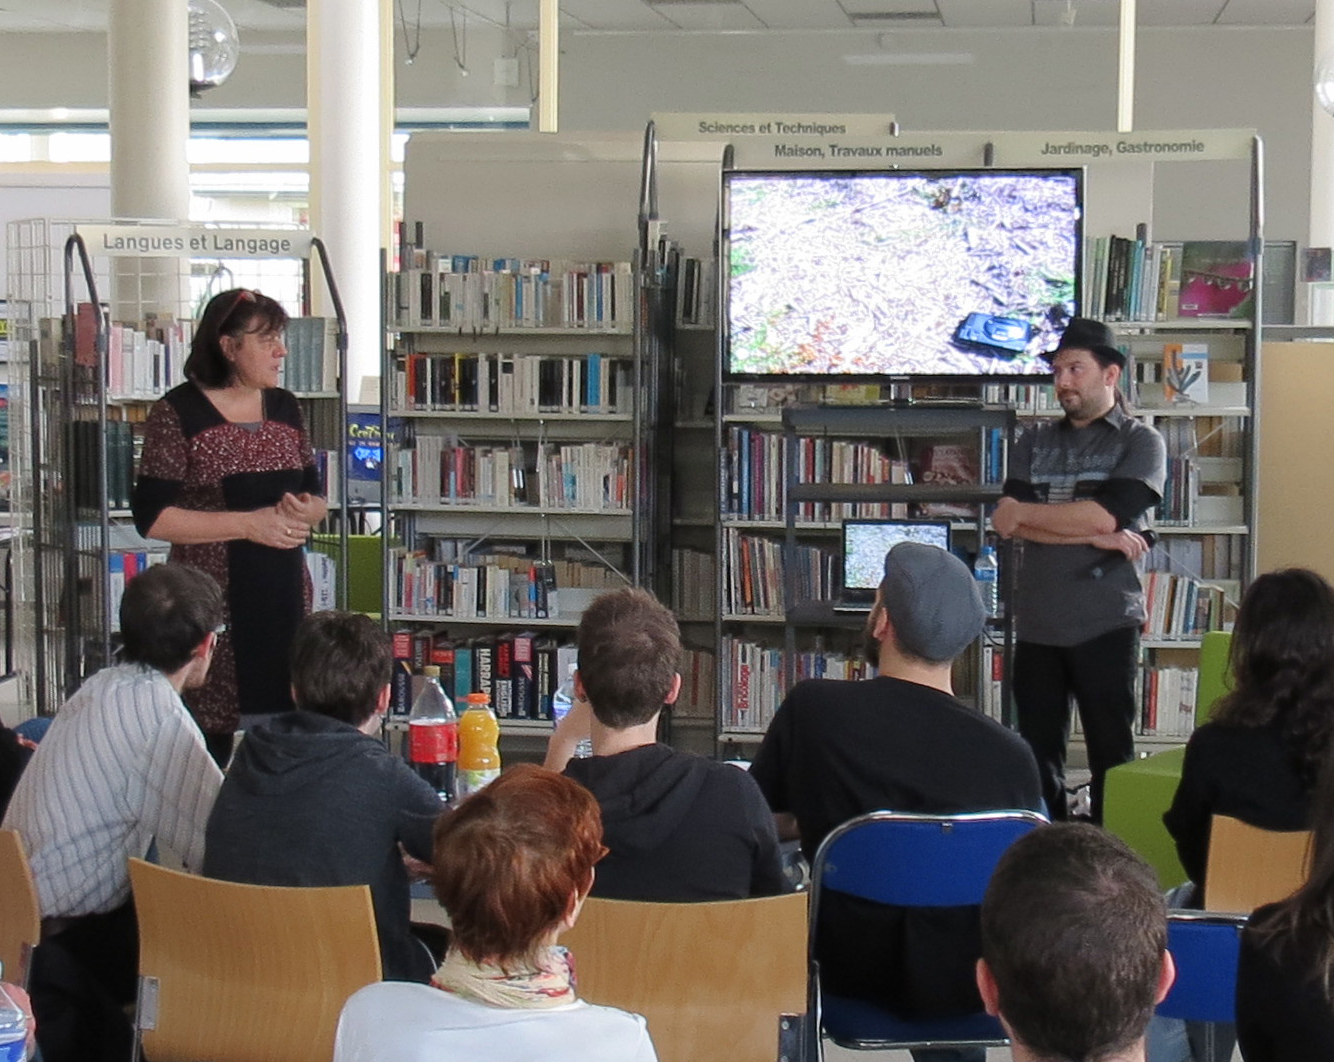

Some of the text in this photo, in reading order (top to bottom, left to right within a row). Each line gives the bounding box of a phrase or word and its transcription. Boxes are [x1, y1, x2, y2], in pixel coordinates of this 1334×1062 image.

[698, 121, 847, 137] Sciences et Techniques
[774, 144, 944, 158] Maison, Travaux manuels
[1041, 139, 1205, 158] Jardinage, Gastronomie
[103, 233, 292, 254] Langues et Langage
